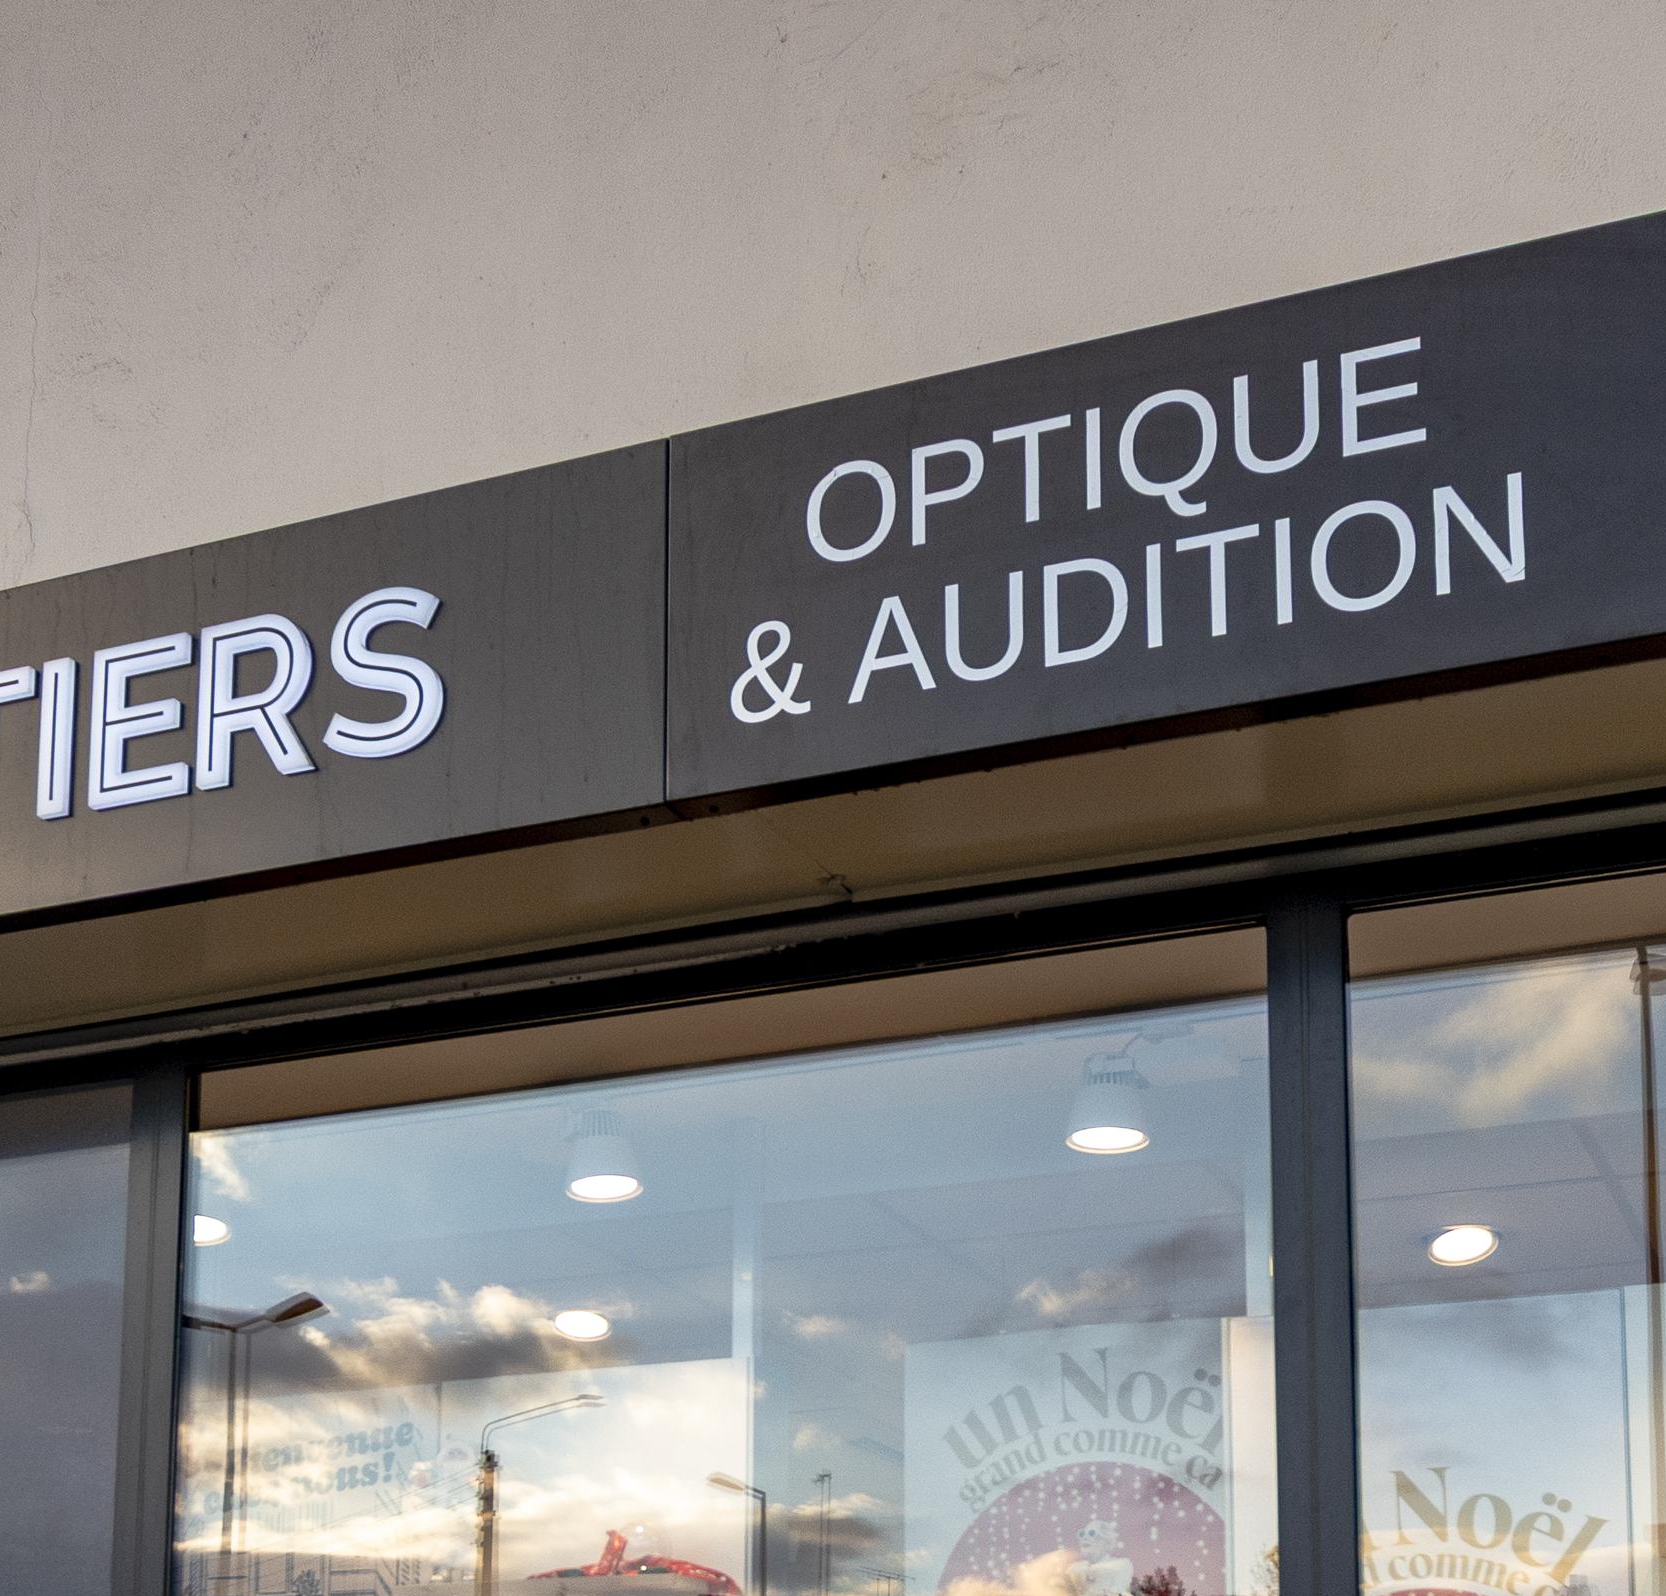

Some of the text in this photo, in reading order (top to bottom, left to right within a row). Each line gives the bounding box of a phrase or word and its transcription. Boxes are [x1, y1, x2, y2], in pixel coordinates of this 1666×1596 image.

[806, 336, 1427, 562] OPTIQUE
[729, 472, 1526, 723] & AUDITION
[943, 1384, 1046, 1469] un
[959, 1425, 1046, 1514] grand
[1053, 1428, 1182, 1466] comme
[1387, 1552, 1531, 1596] comme
[1390, 1467, 1610, 1584] Noël
